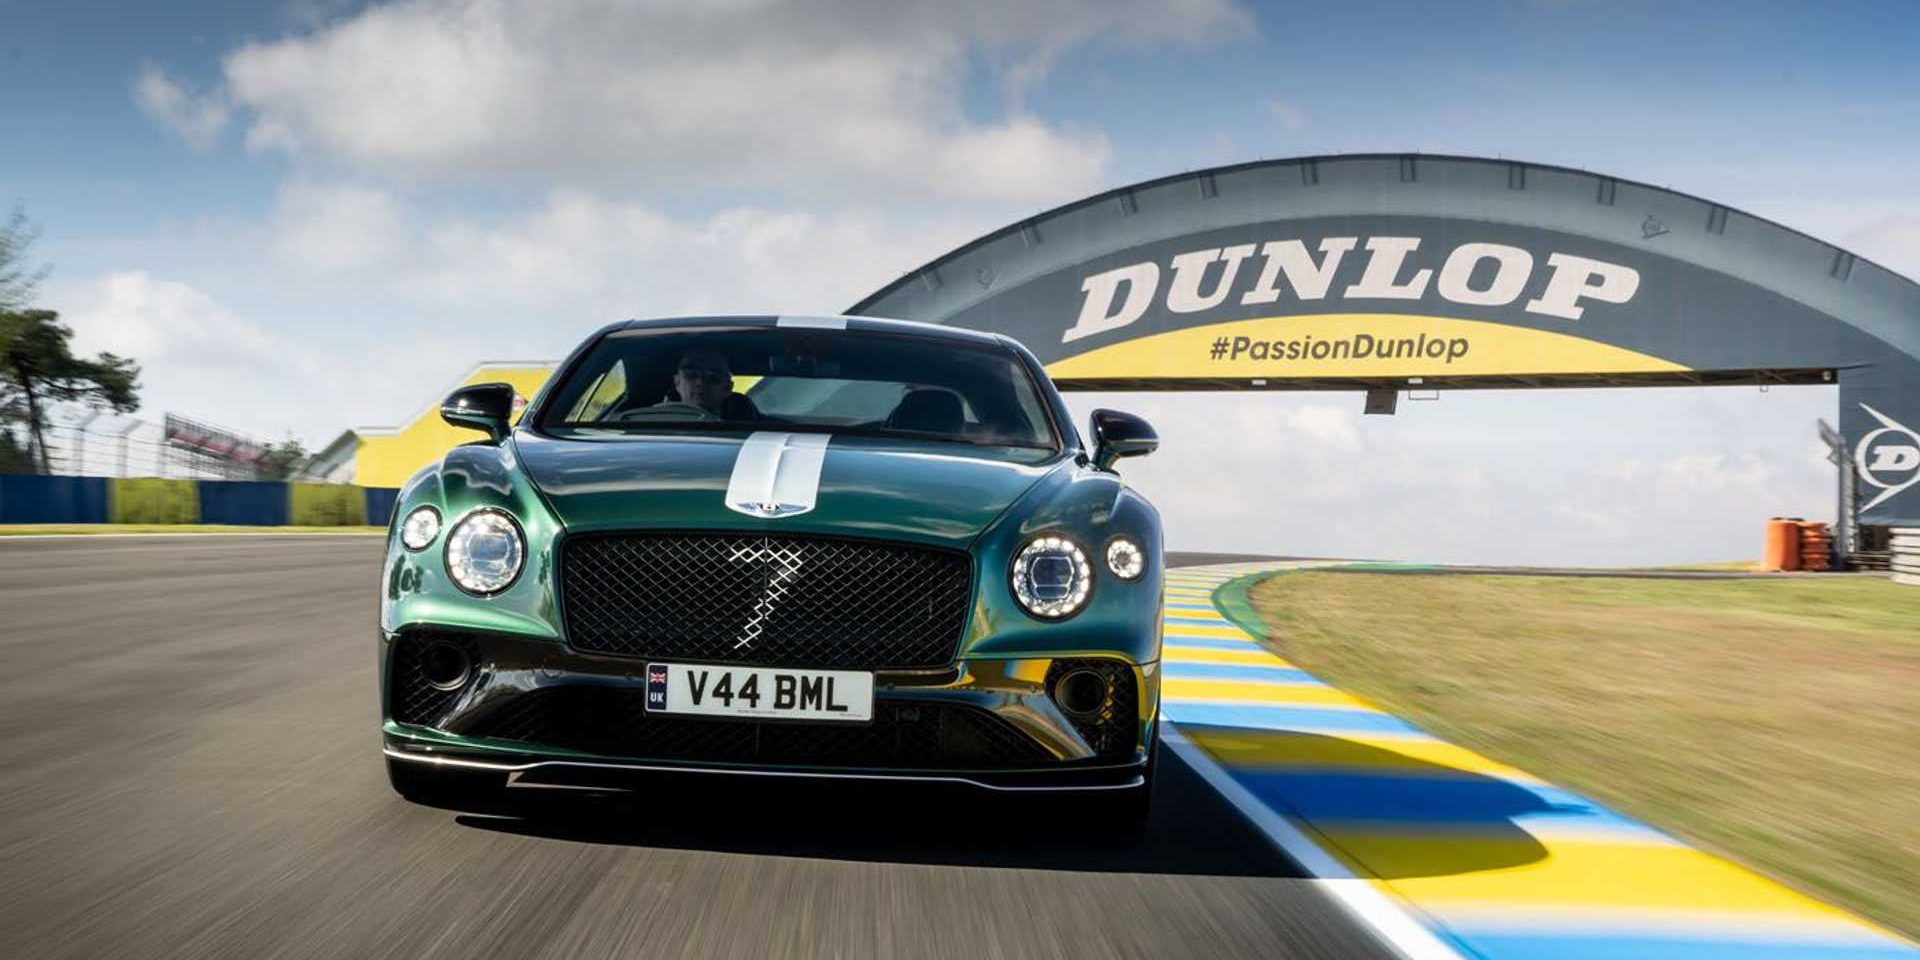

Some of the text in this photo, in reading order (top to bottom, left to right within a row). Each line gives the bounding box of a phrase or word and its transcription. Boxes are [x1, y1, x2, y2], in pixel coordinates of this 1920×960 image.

[1062, 236, 1640, 344] DUNLOP
[1209, 333, 1470, 363] #PassionDunlop
[1869, 445, 1920, 471] D
[687, 670, 849, 712] V44 BML
